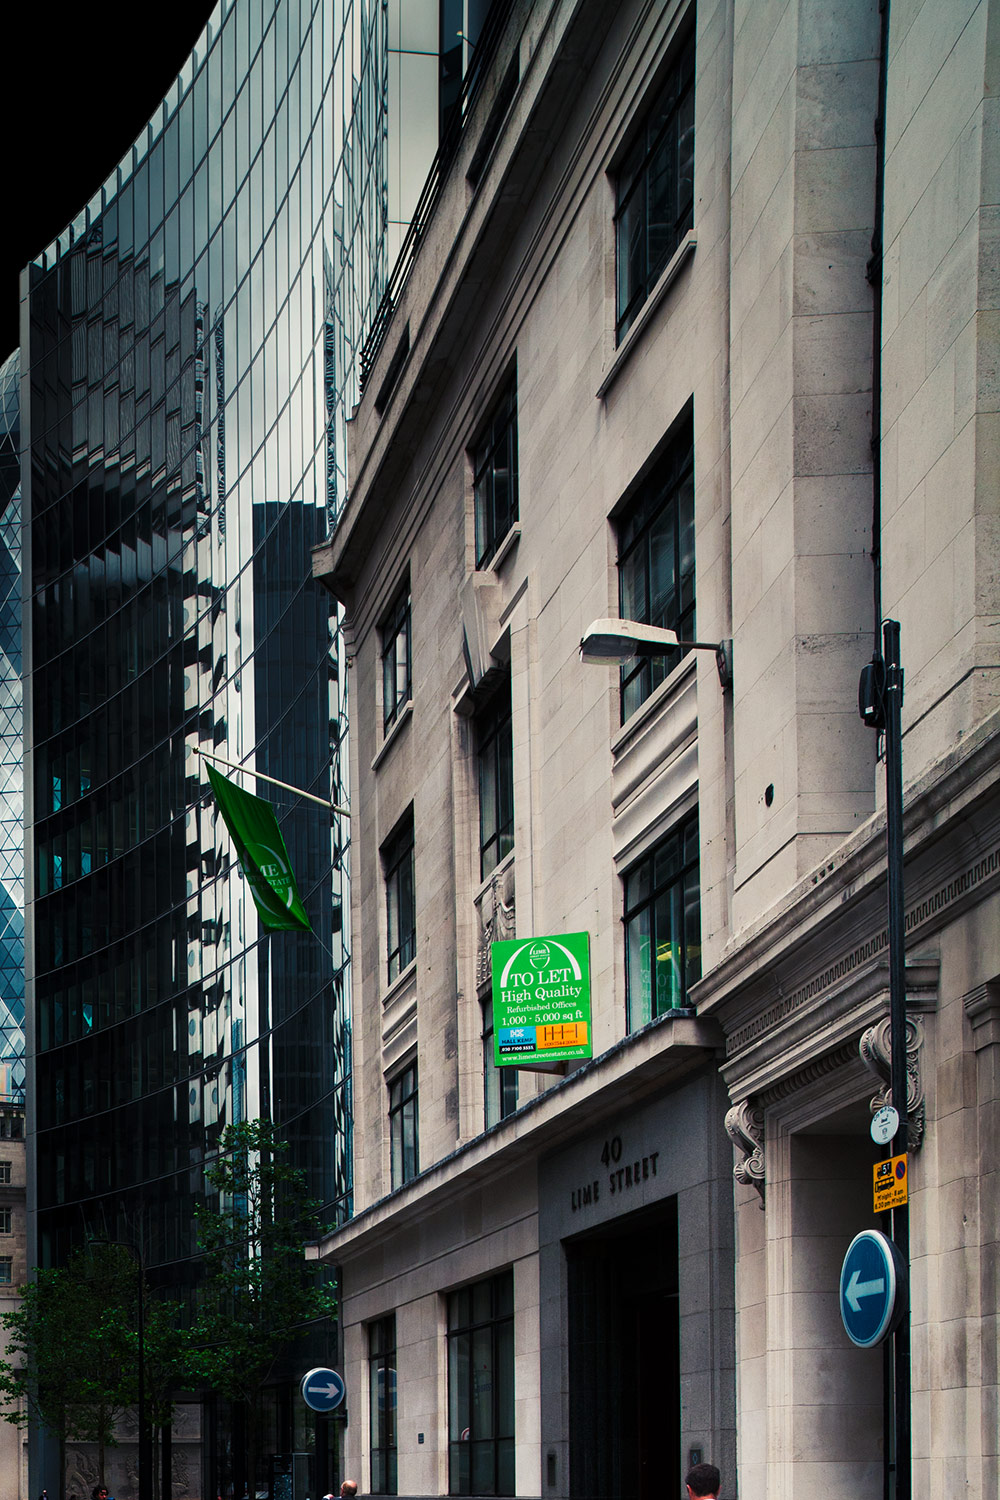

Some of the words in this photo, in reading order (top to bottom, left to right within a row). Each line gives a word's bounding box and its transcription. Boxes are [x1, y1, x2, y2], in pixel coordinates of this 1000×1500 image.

[510, 972, 534, 987] TO
[537, 968, 571, 985] LET
[501, 989, 531, 1003] High
[535, 986, 582, 1001] Quality
[507, 1003, 551, 1014] Refurbished
[551, 1001, 577, 1010] Offices
[502, 1016, 527, 1026] 1,000
[535, 1013, 561, 1024] 5,000
[562, 1012, 574, 1021] sq
[575, 1010, 583, 1019] ft
[502, 1048, 585, 1062] www.limestreetestate.co.uk
[600, 1135, 623, 1168] 40
[571, 1181, 599, 1212] LIME
[609, 1151, 659, 1194] STREET
